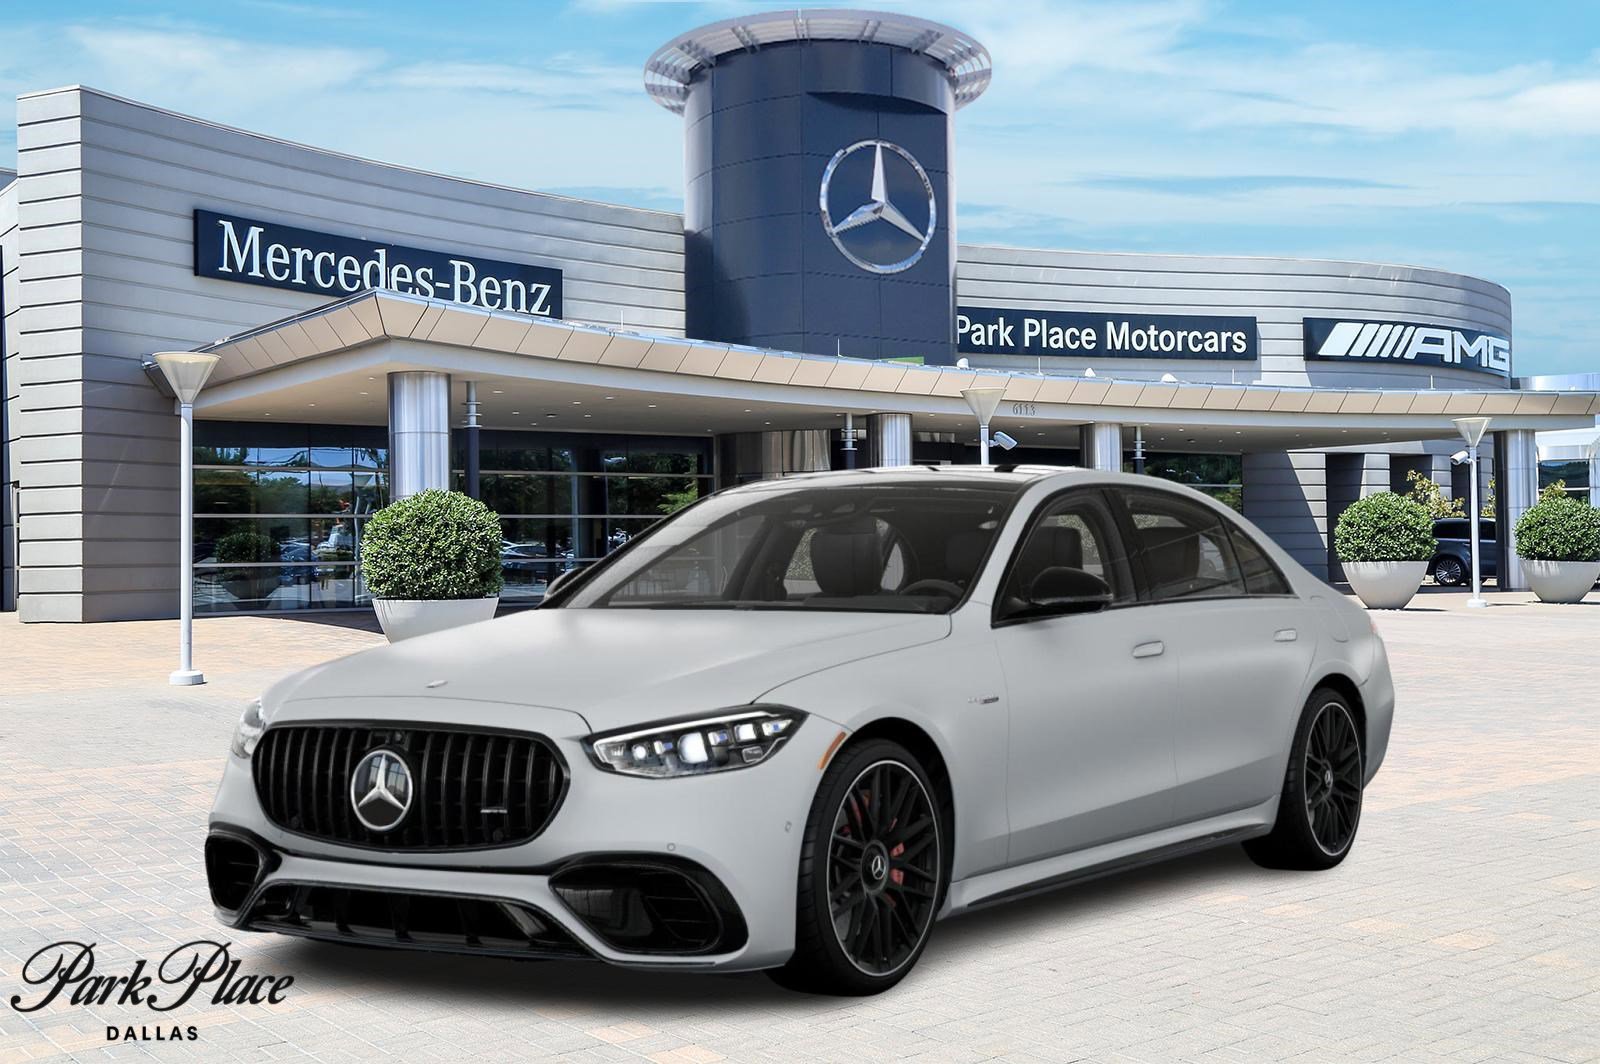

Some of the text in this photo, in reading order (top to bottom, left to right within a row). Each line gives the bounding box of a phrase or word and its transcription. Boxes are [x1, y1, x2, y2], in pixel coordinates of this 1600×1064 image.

[217, 219, 552, 316] Mercedes-Benz
[957, 315, 1248, 354] Park Place Motorcars
[1012, 403, 1036, 416] 6113
